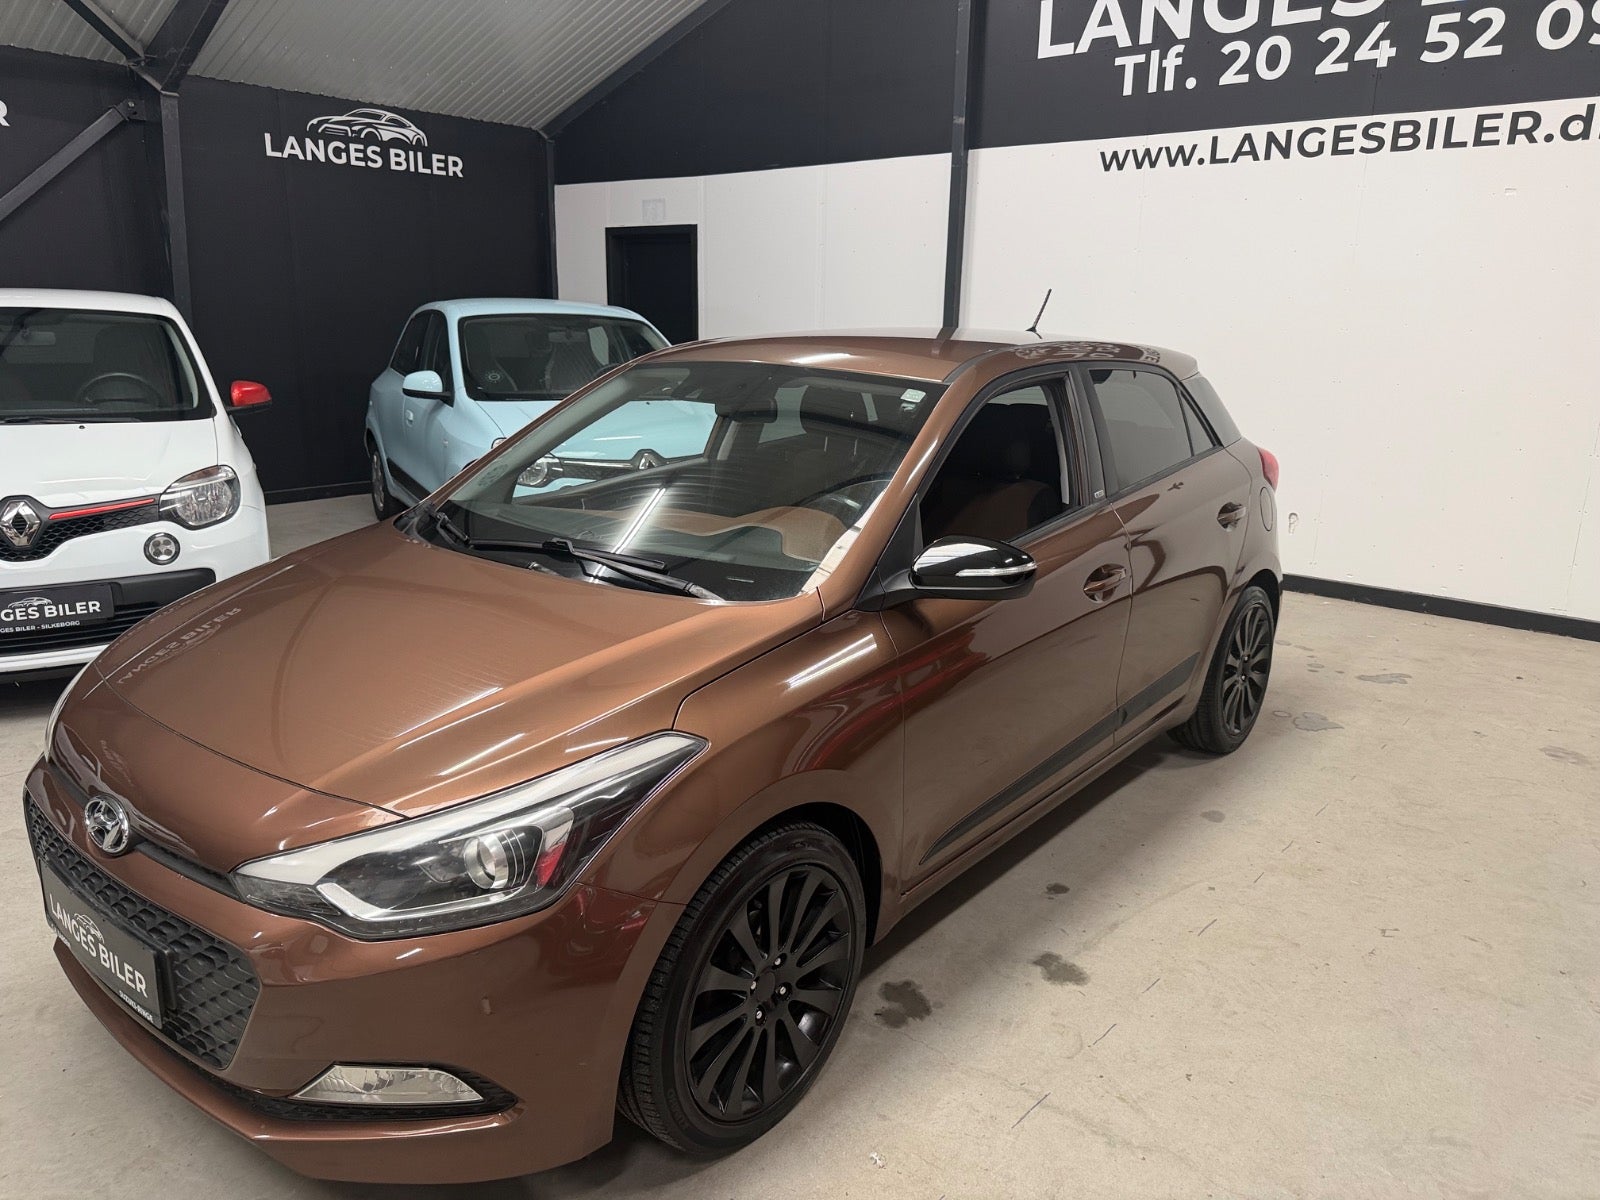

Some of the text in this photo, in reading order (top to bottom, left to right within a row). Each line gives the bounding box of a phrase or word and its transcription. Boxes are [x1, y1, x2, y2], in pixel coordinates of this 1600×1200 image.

[1114, 0, 1600, 96] Tlf. 20 24 52 0
[264, 132, 464, 178] LANGES BILER
[1099, 103, 1600, 172] www.LANGESBILER.d
[44, 600, 101, 618] BILER
[49, 893, 97, 957] LANGES
[98, 942, 148, 998] BILER
